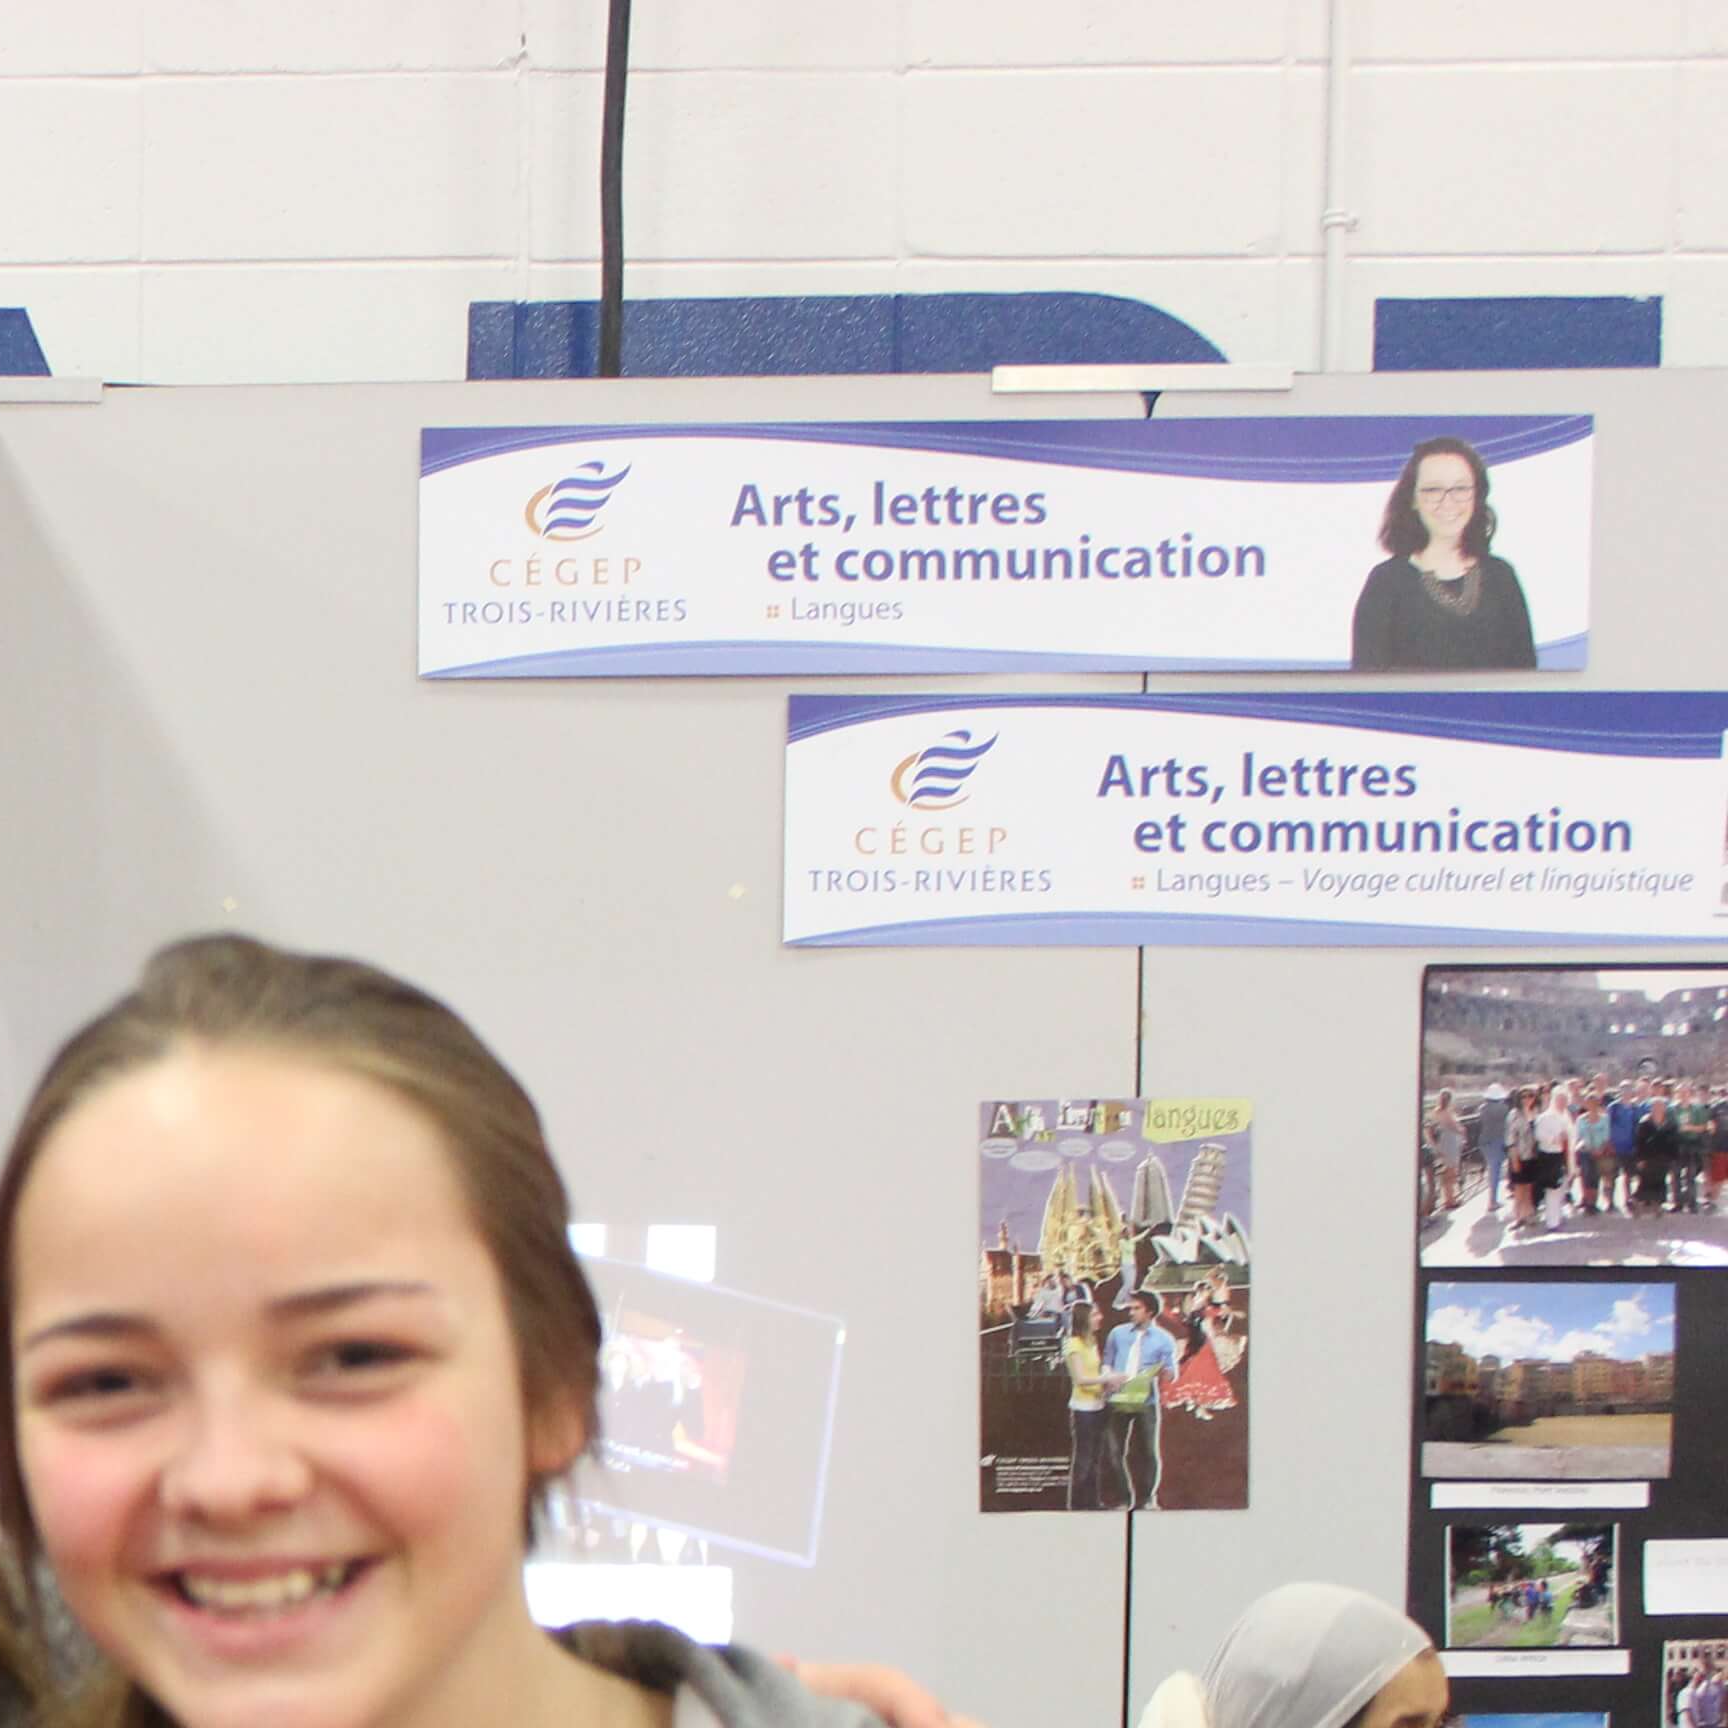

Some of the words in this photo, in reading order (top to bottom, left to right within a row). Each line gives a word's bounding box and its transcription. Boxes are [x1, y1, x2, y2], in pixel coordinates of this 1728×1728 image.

[731, 483, 857, 534] Arts,
[873, 481, 1048, 527] lettres
[489, 551, 643, 589] CÉGEP
[766, 542, 820, 582] et
[834, 532, 1267, 582] communication
[443, 594, 689, 626] TROIS-RIVIÈRES
[791, 596, 905, 626] Langues
[1097, 753, 1226, 805] Arts,
[1241, 750, 1419, 798] lettres
[853, 820, 1010, 857] CÉGEP
[1132, 813, 1186, 853] et
[1200, 805, 1634, 853] communication
[808, 863, 1054, 895] TROIS-RIVIÈRES
[1155, 867, 1271, 898] Langues
[1302, 866, 1399, 898] Voyage
[1404, 865, 1506, 894] culturel
[1508, 870, 1535, 893] et
[1539, 865, 1694, 899] linguistique
